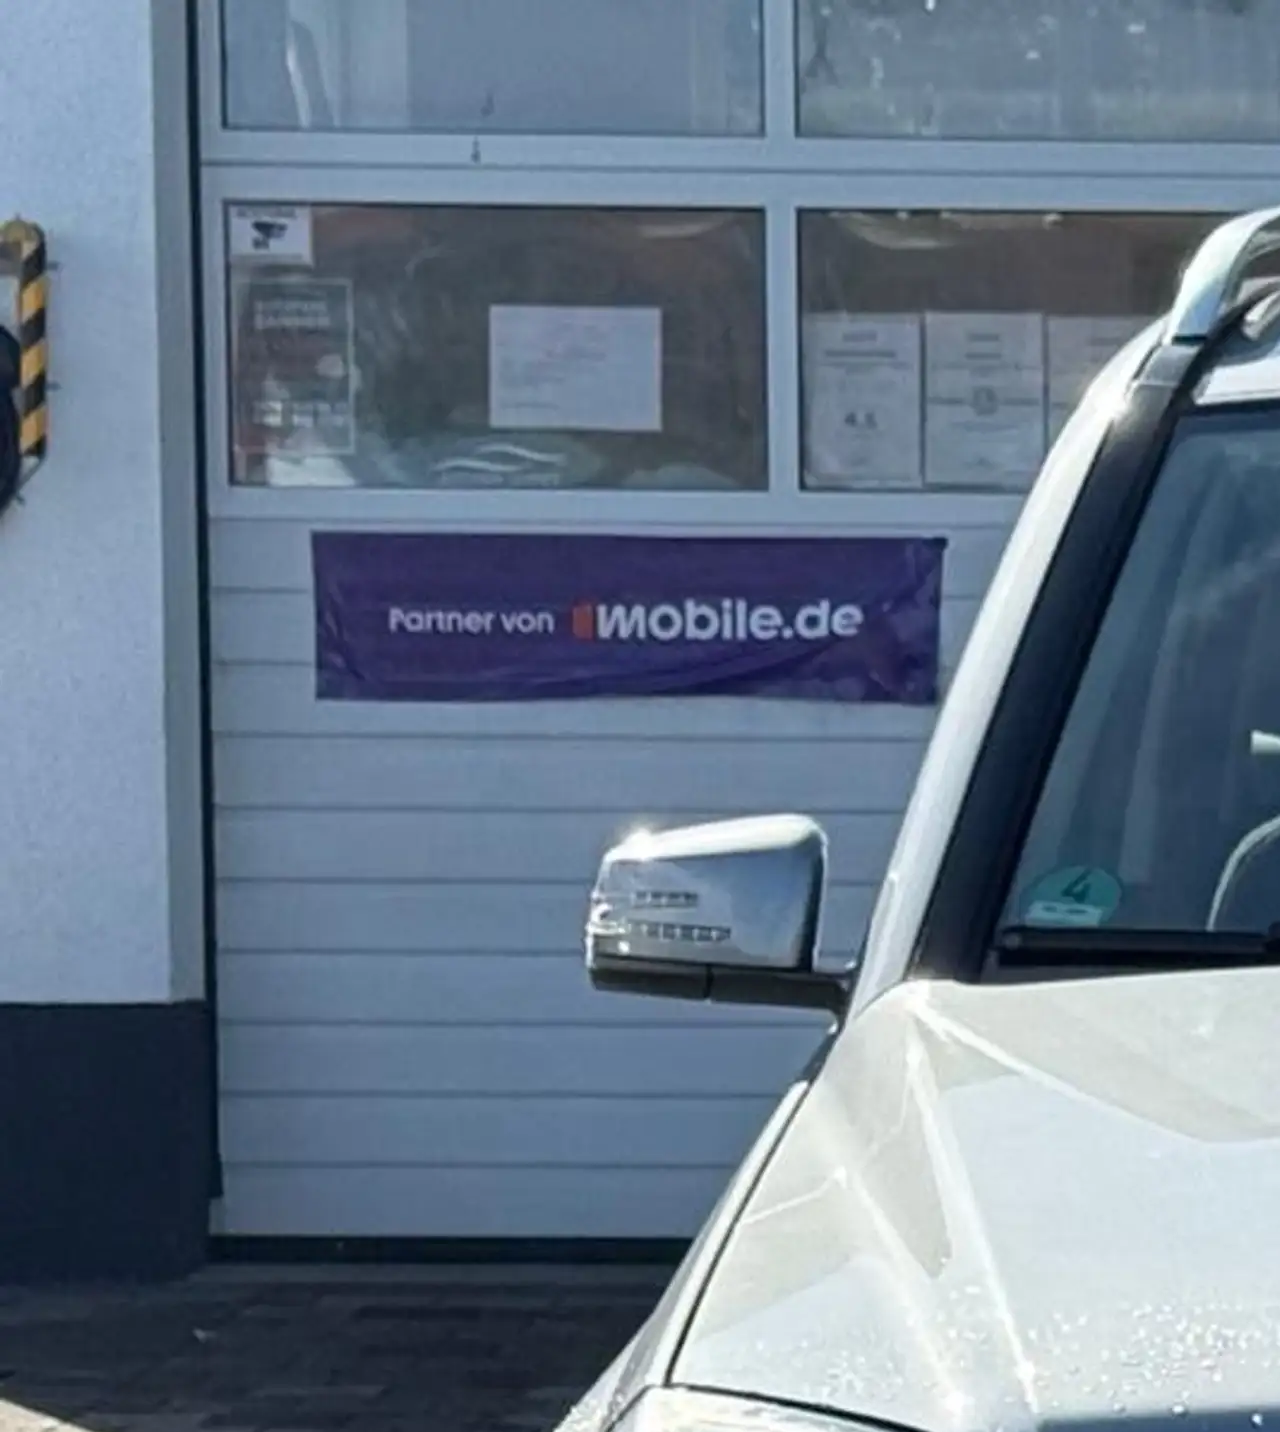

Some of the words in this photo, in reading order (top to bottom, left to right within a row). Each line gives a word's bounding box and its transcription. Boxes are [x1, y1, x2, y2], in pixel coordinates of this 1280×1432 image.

[389, 607, 493, 635] Partner
[502, 612, 555, 635] von
[597, 598, 865, 642] mobile.de
[1062, 868, 1093, 905] 4
